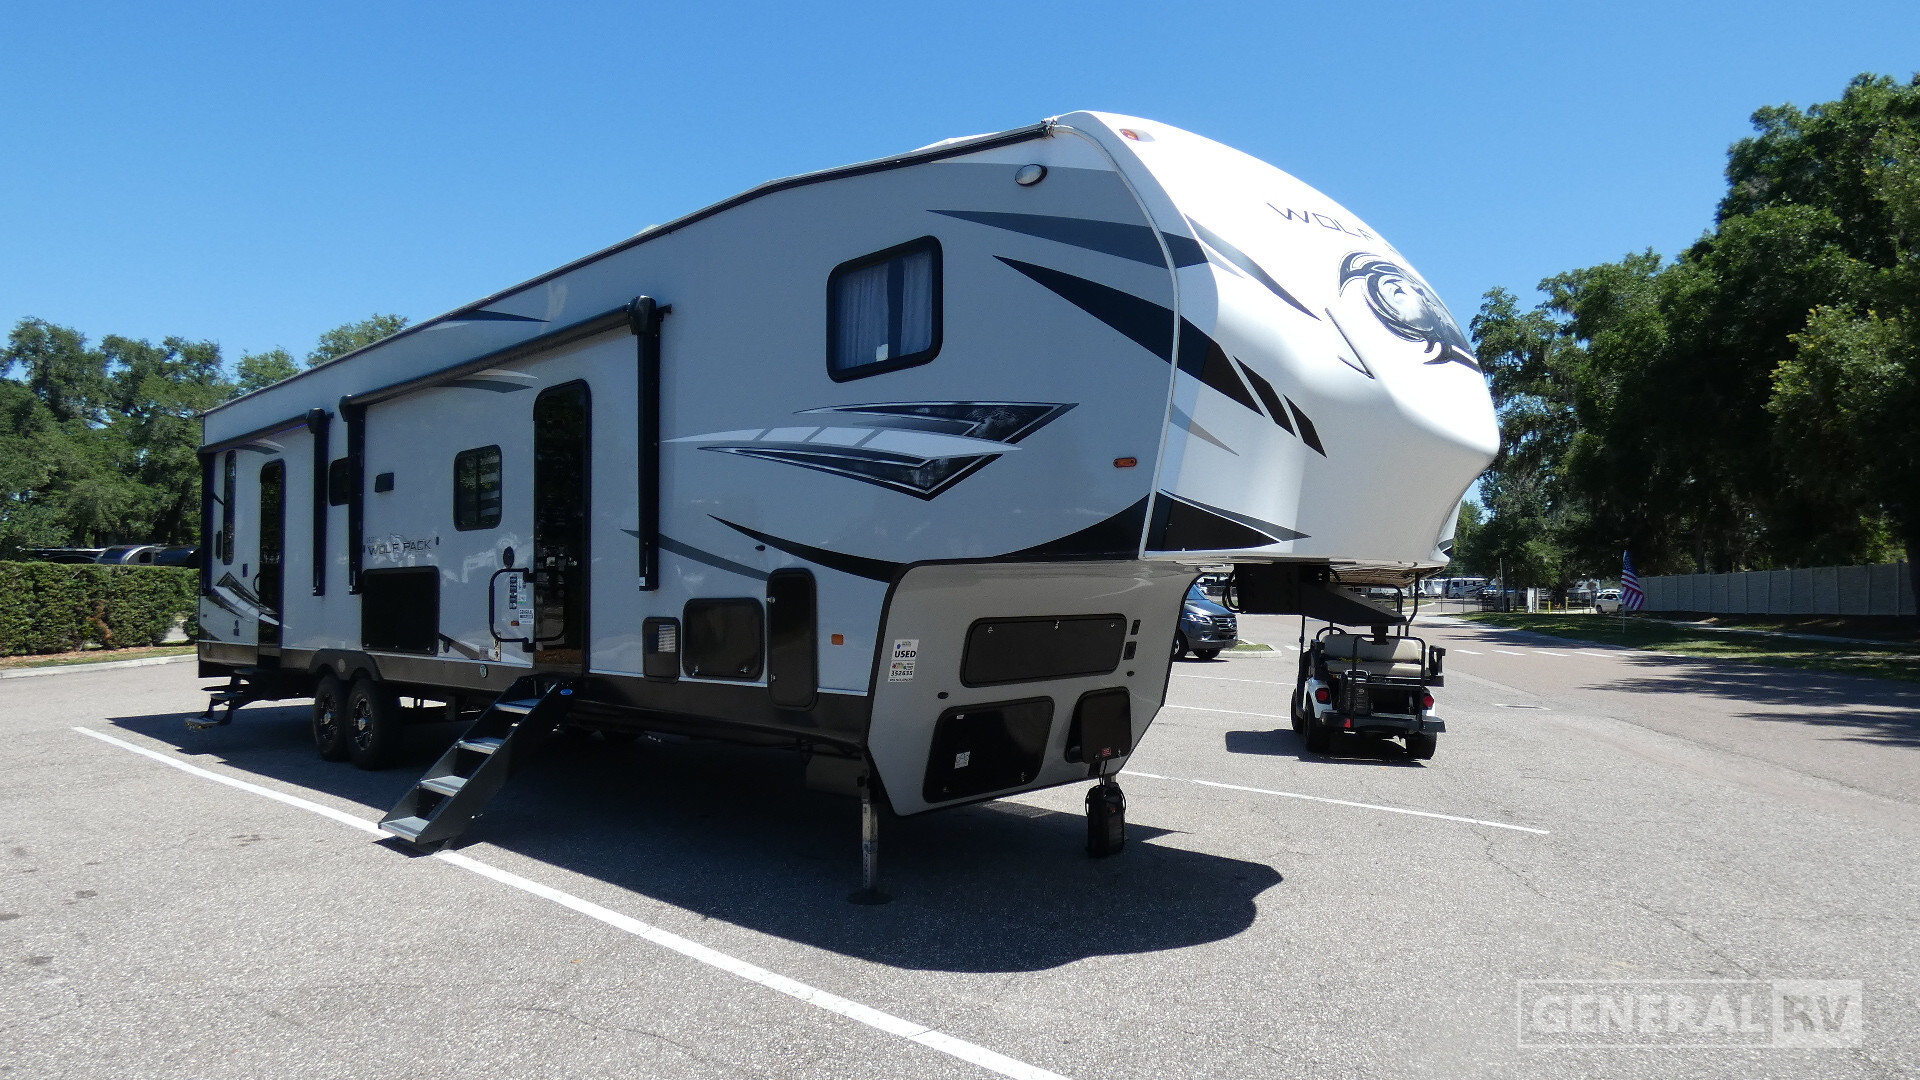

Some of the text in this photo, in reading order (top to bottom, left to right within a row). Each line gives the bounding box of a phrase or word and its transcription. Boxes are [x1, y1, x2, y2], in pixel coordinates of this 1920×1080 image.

[1266, 202, 1375, 241] WOLF
[367, 539, 431, 555] WOLF PACK
[894, 650, 917, 658] USED
